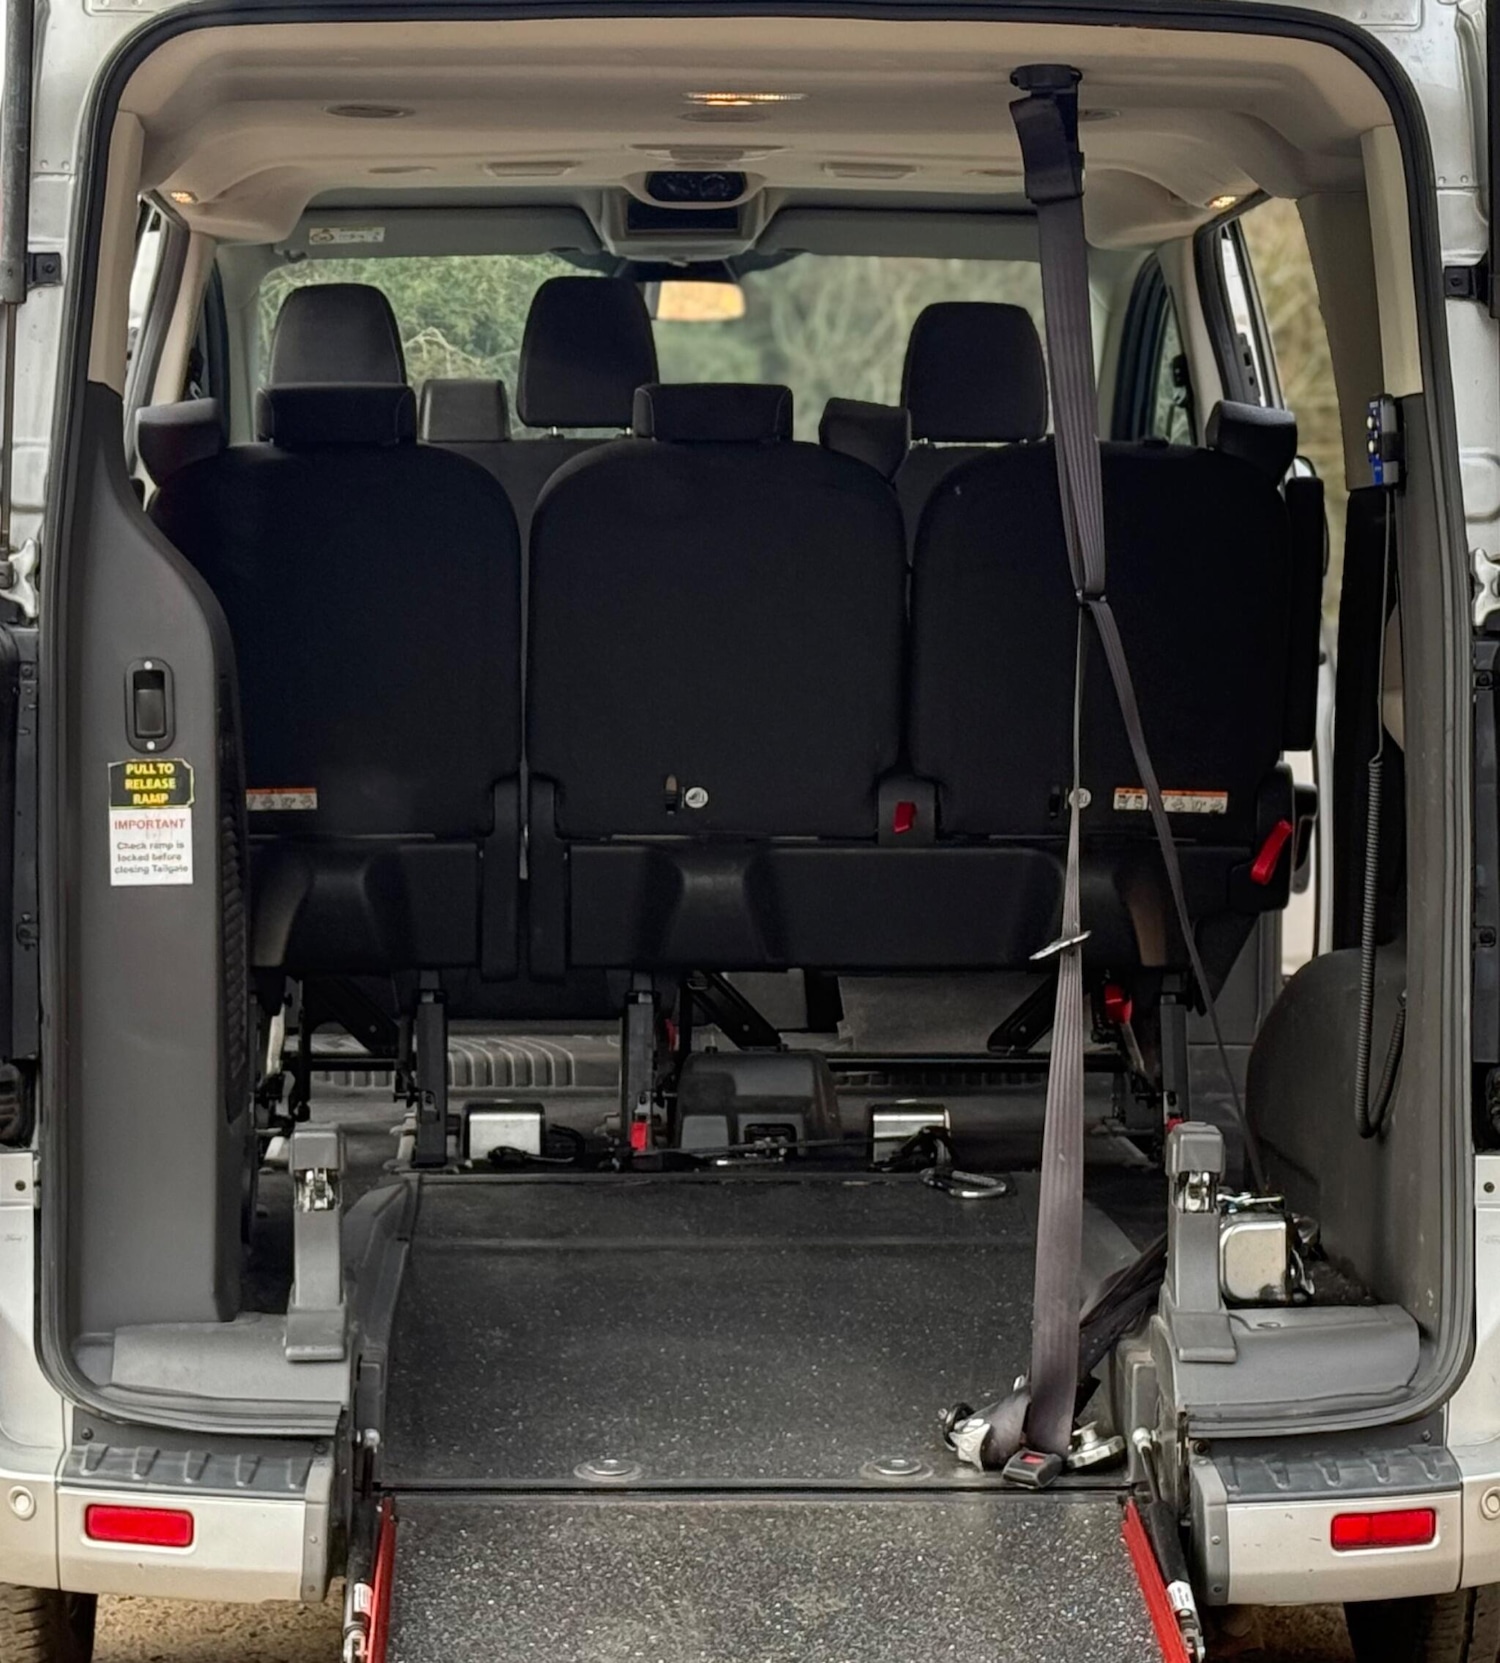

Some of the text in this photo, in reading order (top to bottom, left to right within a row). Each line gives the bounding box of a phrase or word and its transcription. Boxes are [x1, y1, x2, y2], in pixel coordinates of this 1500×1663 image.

[126, 763, 174, 775] PULL TO
[125, 778, 176, 790] RELEASE
[133, 793, 169, 804] RAMP
[114, 819, 185, 830] IMPORTANT
[117, 840, 184, 850] Check ramp is
[118, 853, 182, 862] locked before
[115, 864, 188, 875] closing Tailgate
